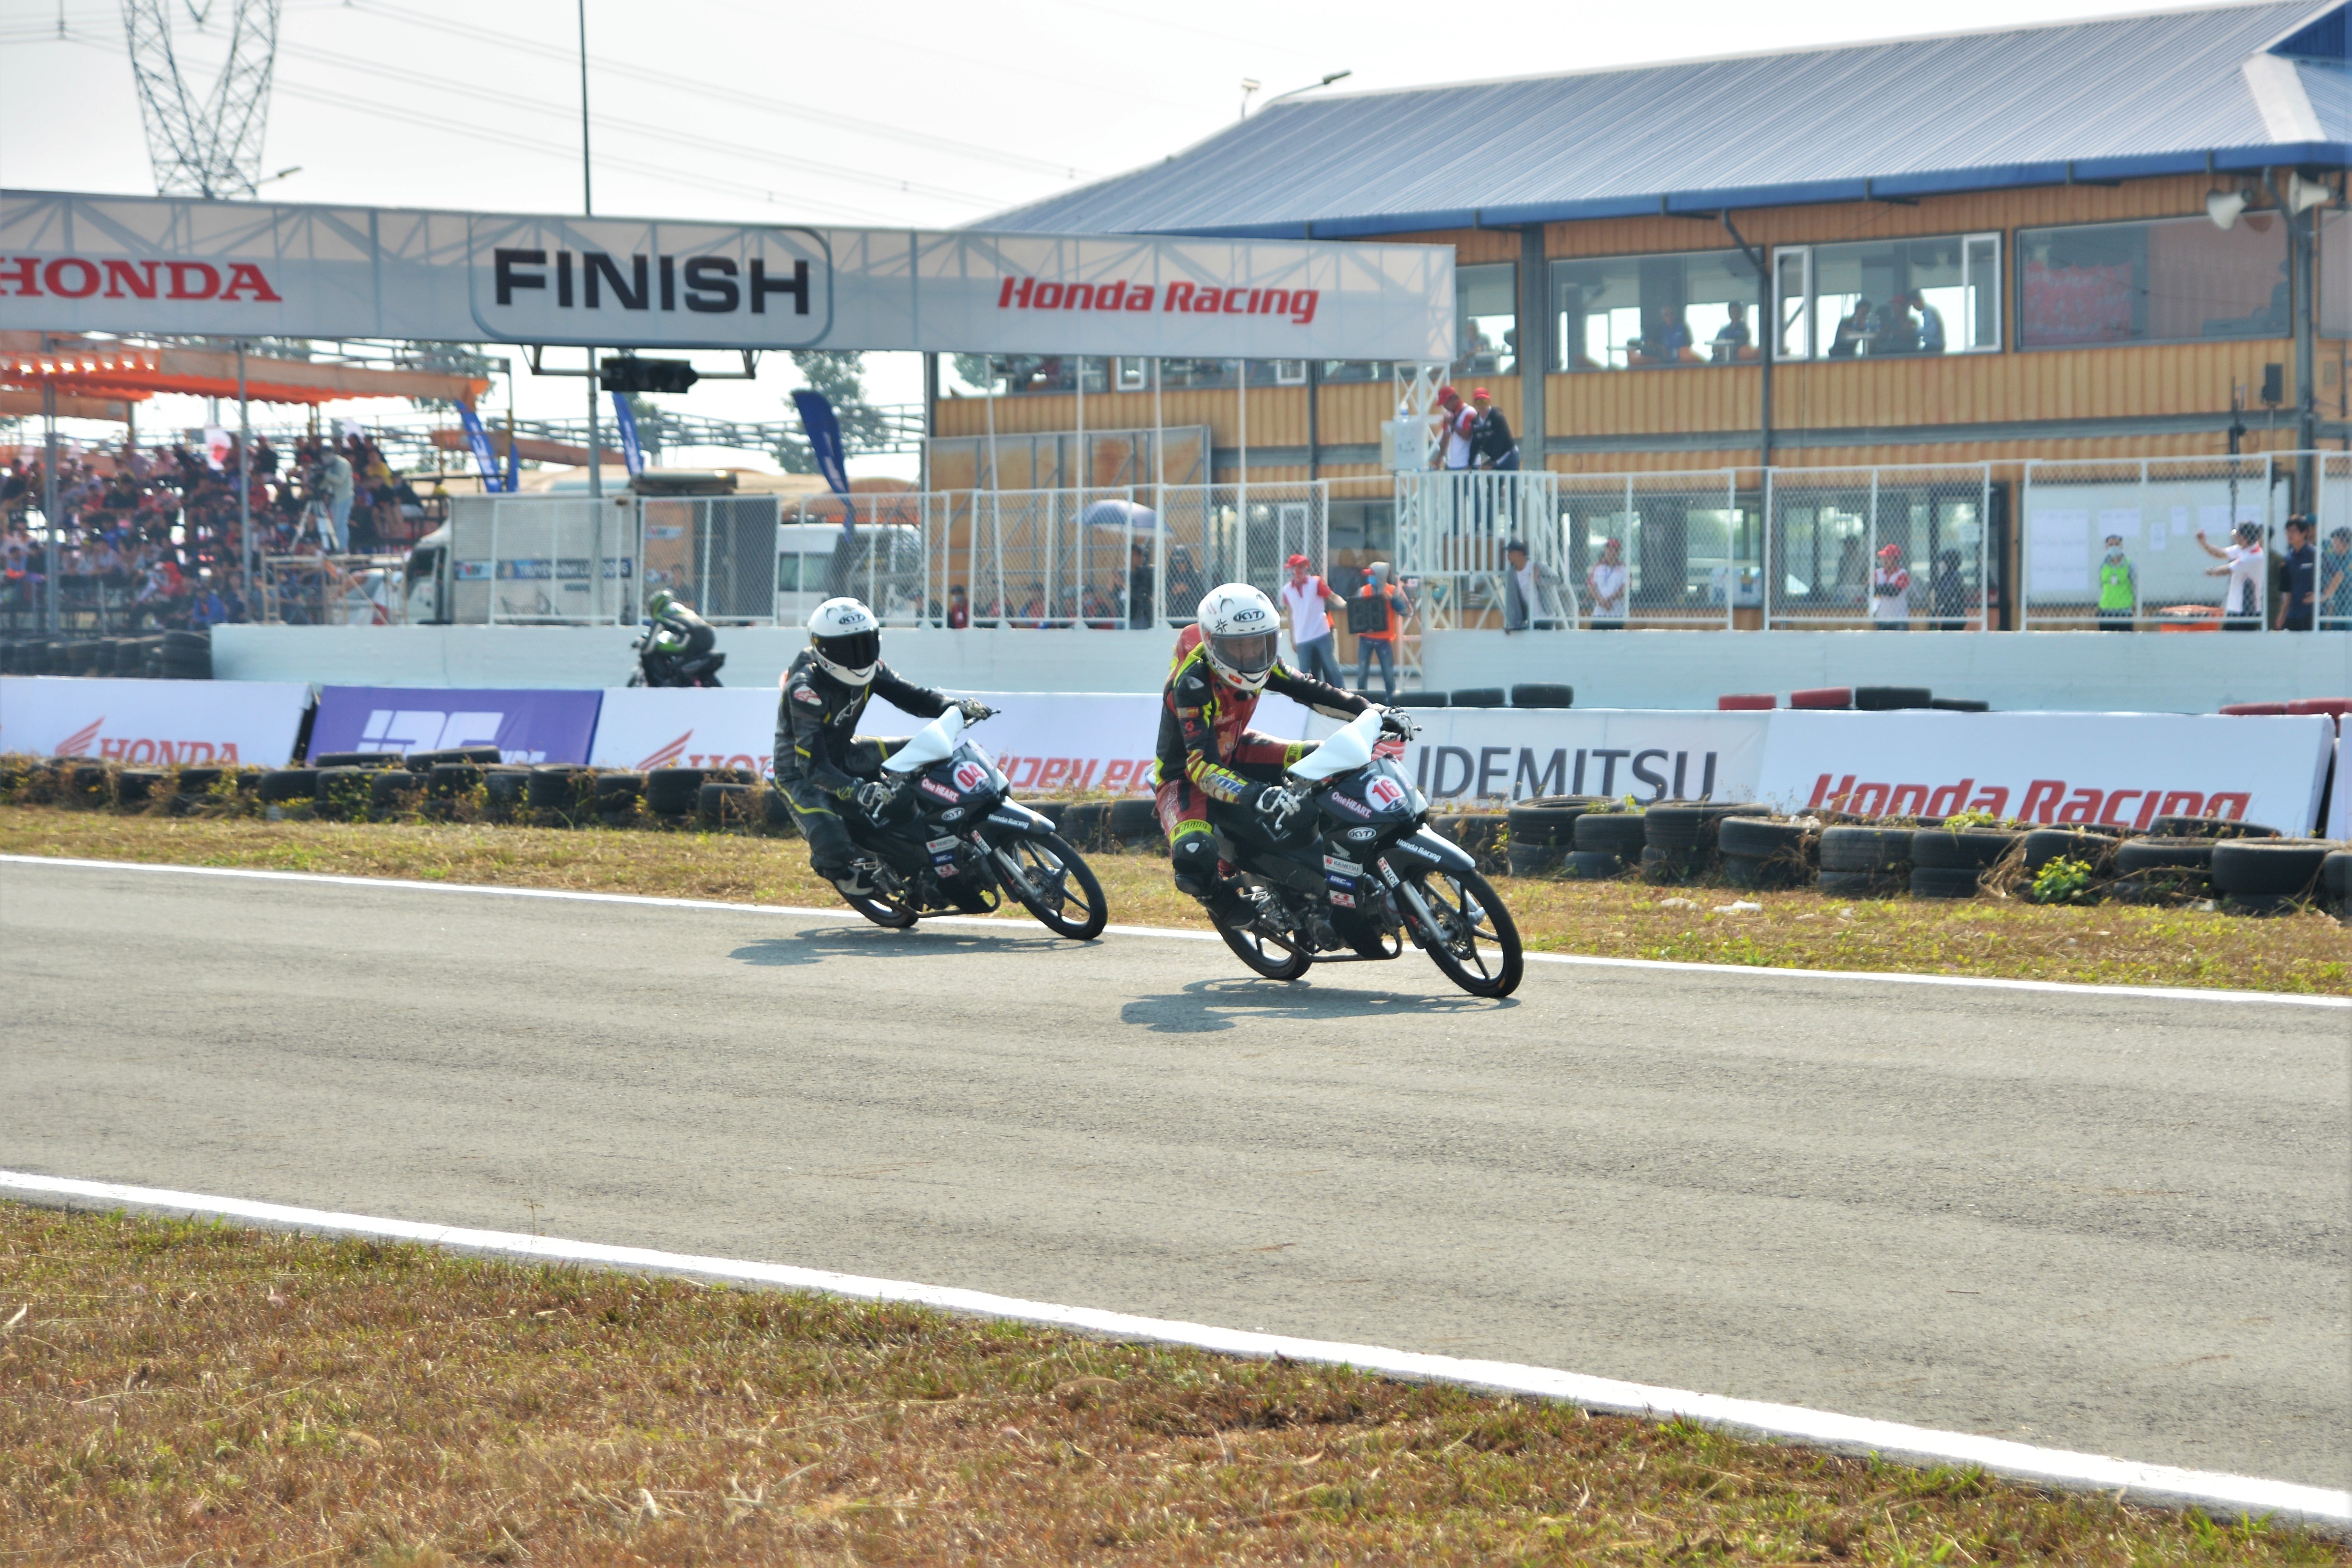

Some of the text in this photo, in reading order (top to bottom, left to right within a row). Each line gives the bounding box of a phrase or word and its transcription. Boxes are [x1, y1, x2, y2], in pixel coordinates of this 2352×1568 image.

[0, 257, 283, 302] HONDA
[494, 247, 809, 315] FINISH
[998, 275, 1320, 324] Honda Racing
[842, 613, 862, 624] KYT
[1236, 610, 1262, 622] KYT
[957, 763, 985, 788] 04
[1416, 745, 1717, 805] IDEMITSU
[1372, 778, 1401, 804] 16
[1807, 773, 2010, 822] Honda
[987, 813, 1030, 829] Honda Racing
[1350, 829, 1372, 838] KYT
[1396, 838, 1442, 862] Honda Racing
[1334, 860, 1359, 871] IDEMITSU
